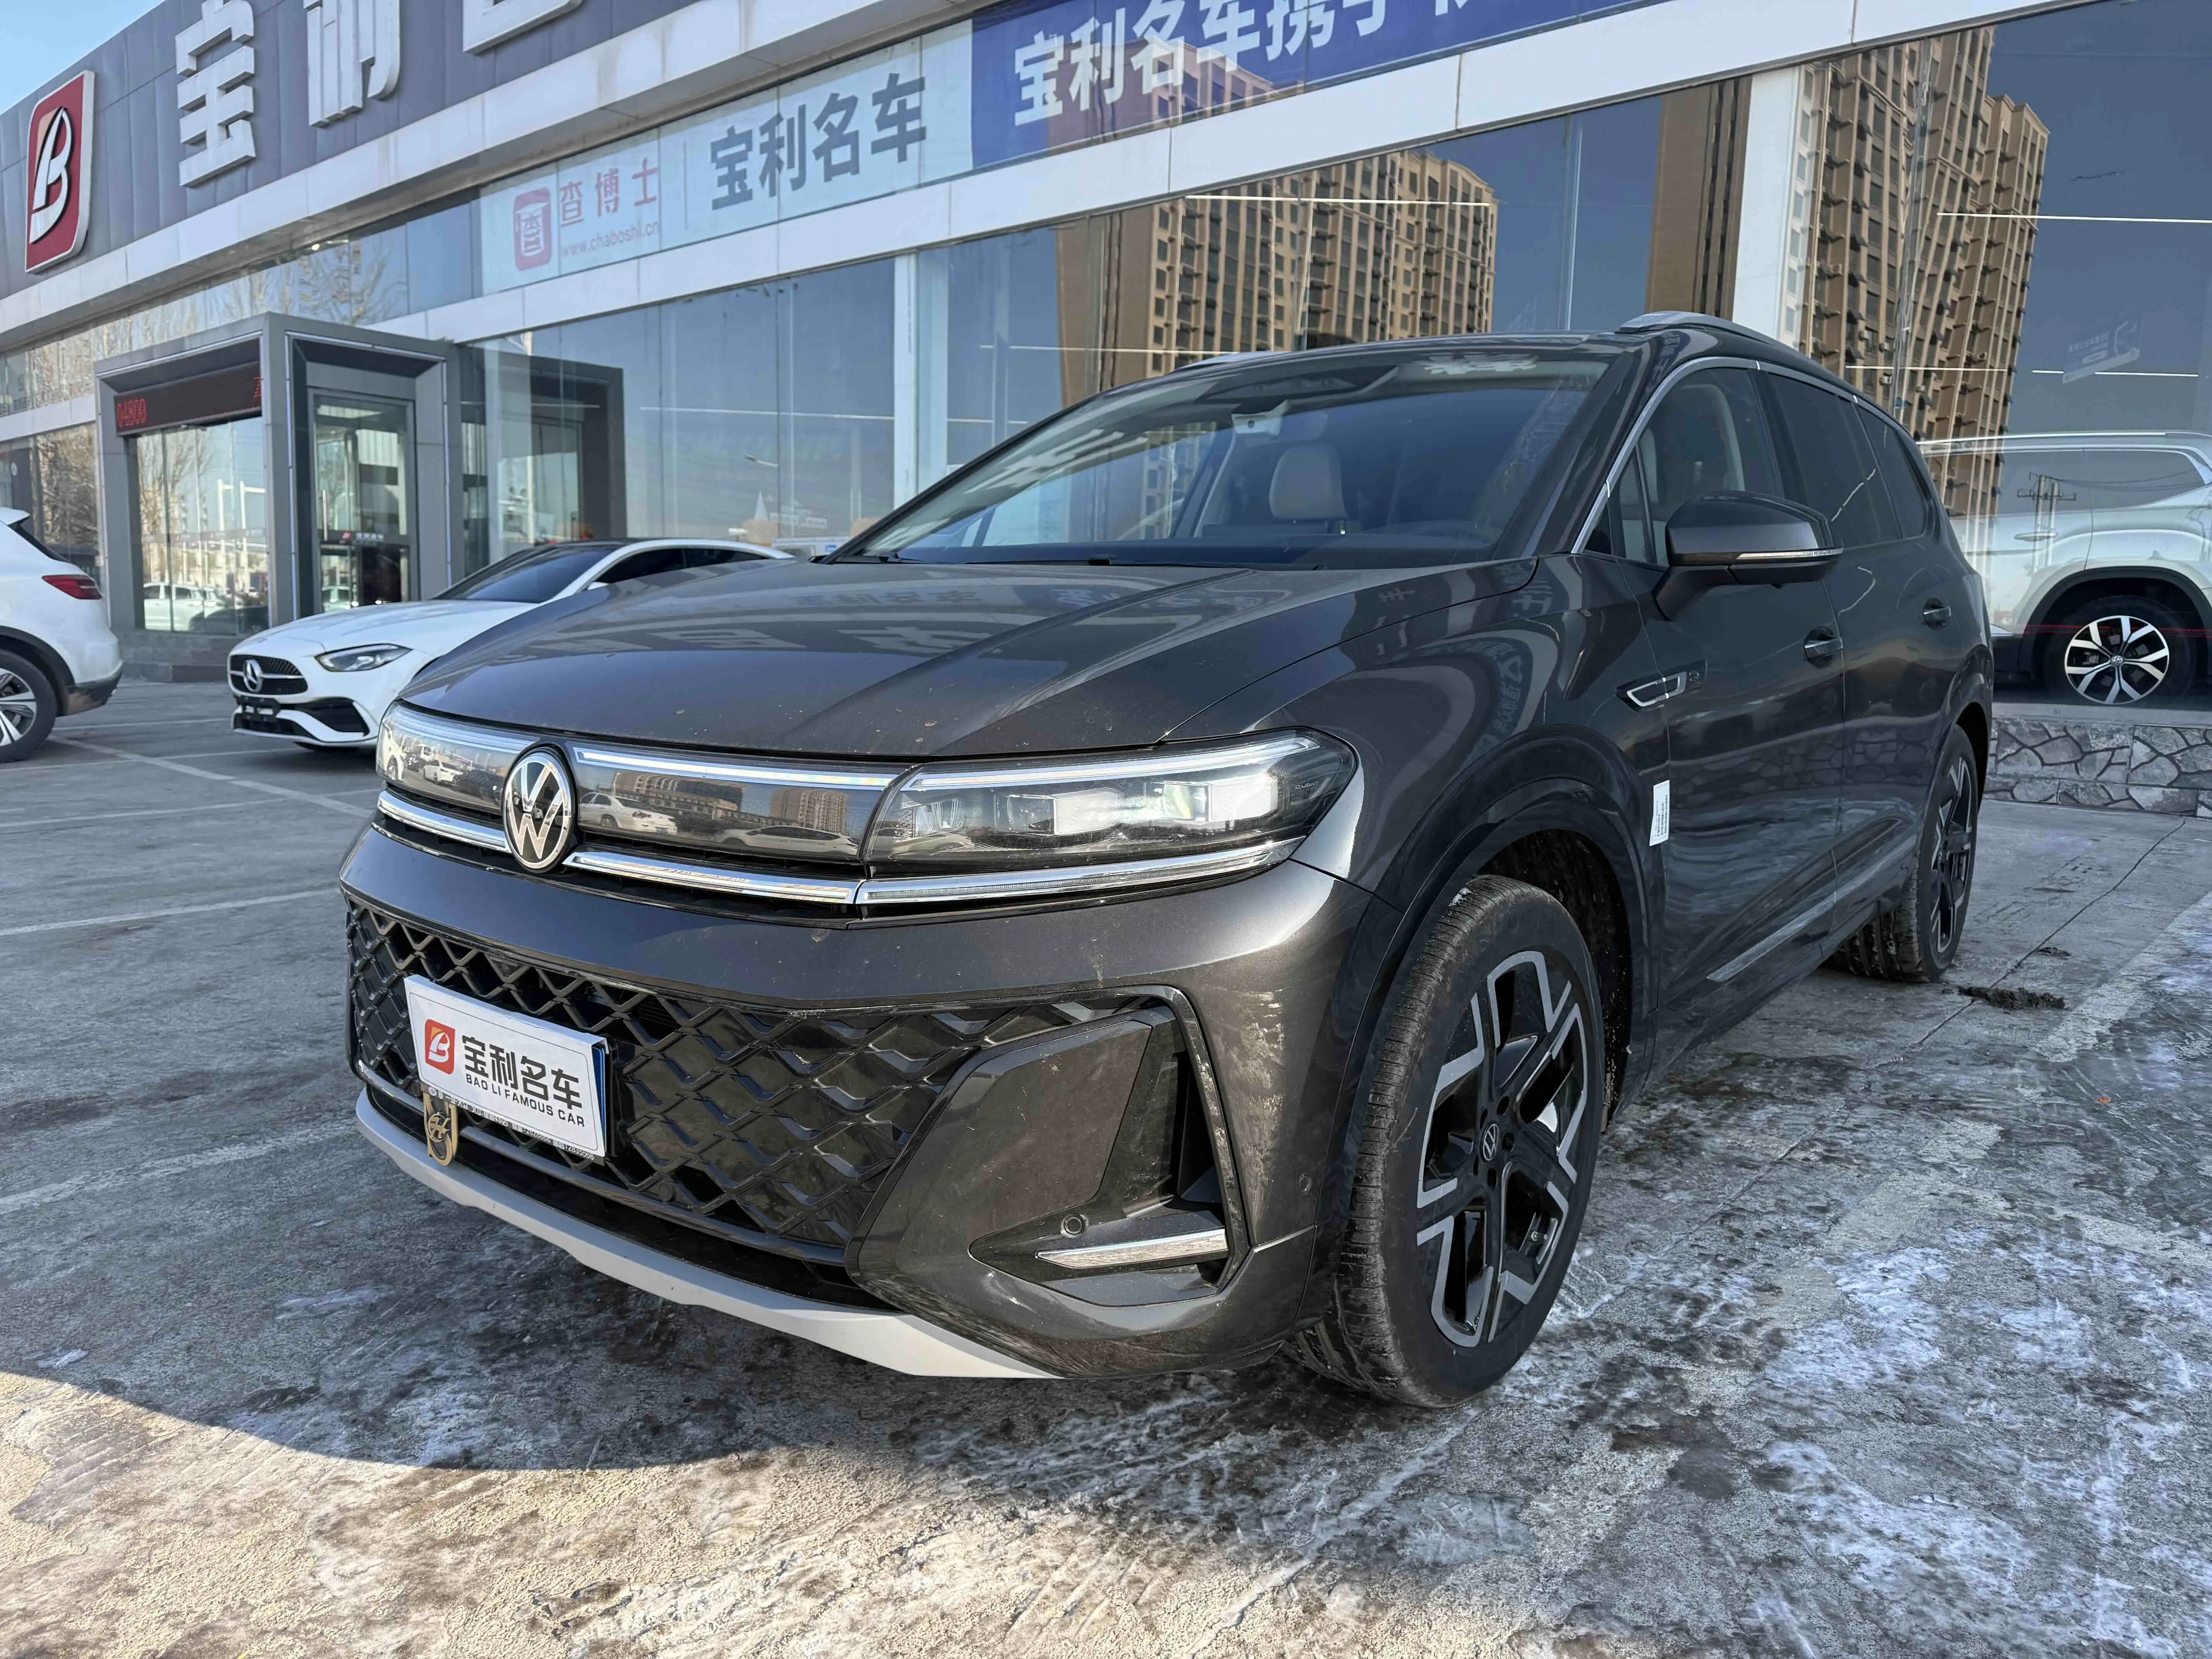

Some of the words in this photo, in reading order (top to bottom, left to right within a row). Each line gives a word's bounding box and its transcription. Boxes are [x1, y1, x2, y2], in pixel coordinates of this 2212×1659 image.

[710, 73, 927, 211] 宝利名车
[560, 157, 659, 227] 查博士
[462, 1035, 582, 1110] 宝利名车
[466, 1073, 488, 1091] BAO
[491, 1083, 501, 1096] LI
[505, 1089, 554, 1116] FAMOUS
[558, 1109, 585, 1127] CAR
